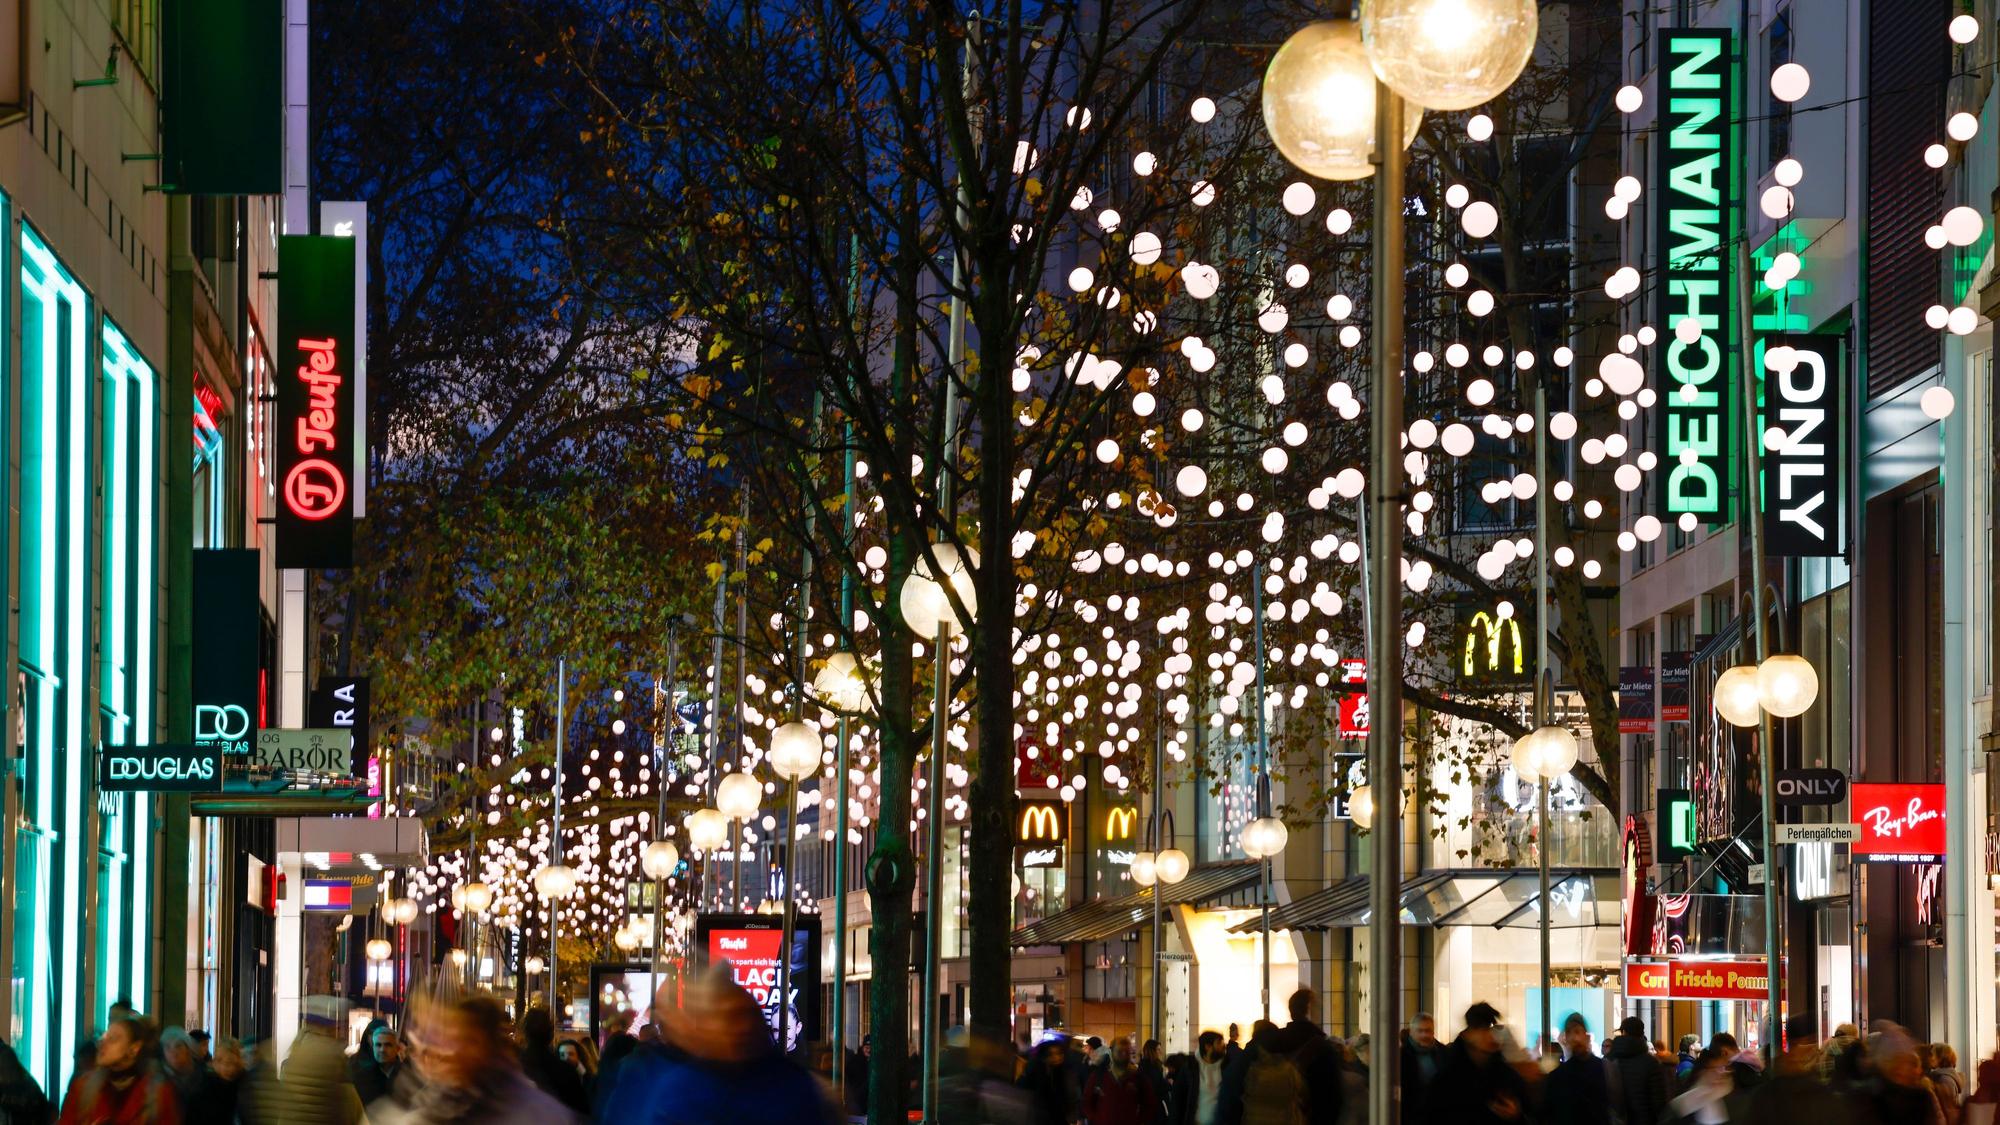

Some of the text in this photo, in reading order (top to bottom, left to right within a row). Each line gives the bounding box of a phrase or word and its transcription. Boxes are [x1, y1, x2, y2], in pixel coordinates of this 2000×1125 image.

[1667, 37, 1722, 514] DEICHMANN
[298, 338, 341, 454] Teufel
[1778, 349, 1826, 541] ONLY
[1632, 681, 1652, 690] Miete
[110, 757, 214, 780] DOUGLAS
[252, 747, 345, 770] BABOR
[1776, 779, 1840, 795] ONLY
[1863, 797, 1938, 838] Ray-Ban
[1787, 827, 1852, 842] Perlengäßchen
[1796, 842, 1832, 901] ONLY
[1675, 969, 1769, 990] Frische Pomm
